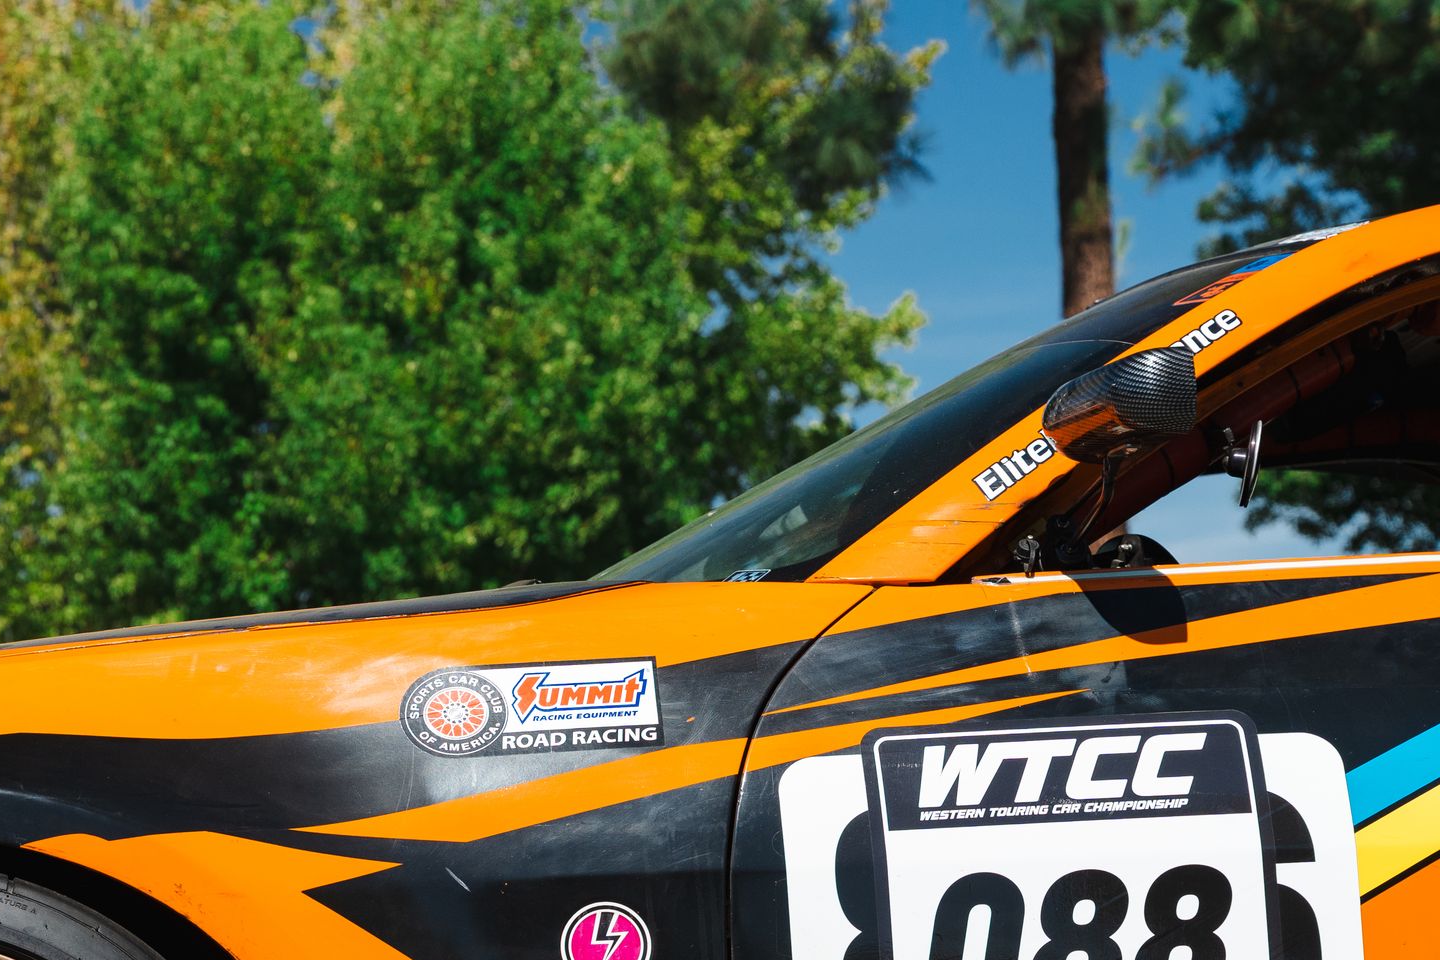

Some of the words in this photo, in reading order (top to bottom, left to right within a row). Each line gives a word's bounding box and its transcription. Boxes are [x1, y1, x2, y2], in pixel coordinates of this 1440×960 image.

[410, 677, 444, 720] SPORTS
[448, 675, 479, 687] CAR
[481, 684, 503, 715] CLUB
[533, 713, 573, 722] RACING
[576, 710, 639, 721] EQUIPMENT
[419, 731, 437, 745] OF
[439, 726, 500, 752] AMERICA
[502, 732, 568, 750] ROAD
[572, 727, 657, 745] RACING
[918, 732, 1208, 808] WTCC
[919, 807, 985, 822] WESTERN
[989, 804, 1049, 818] TOURING
[1052, 803, 1081, 815] CAR
[1084, 798, 1190, 813] CHAMPIONSHIP
